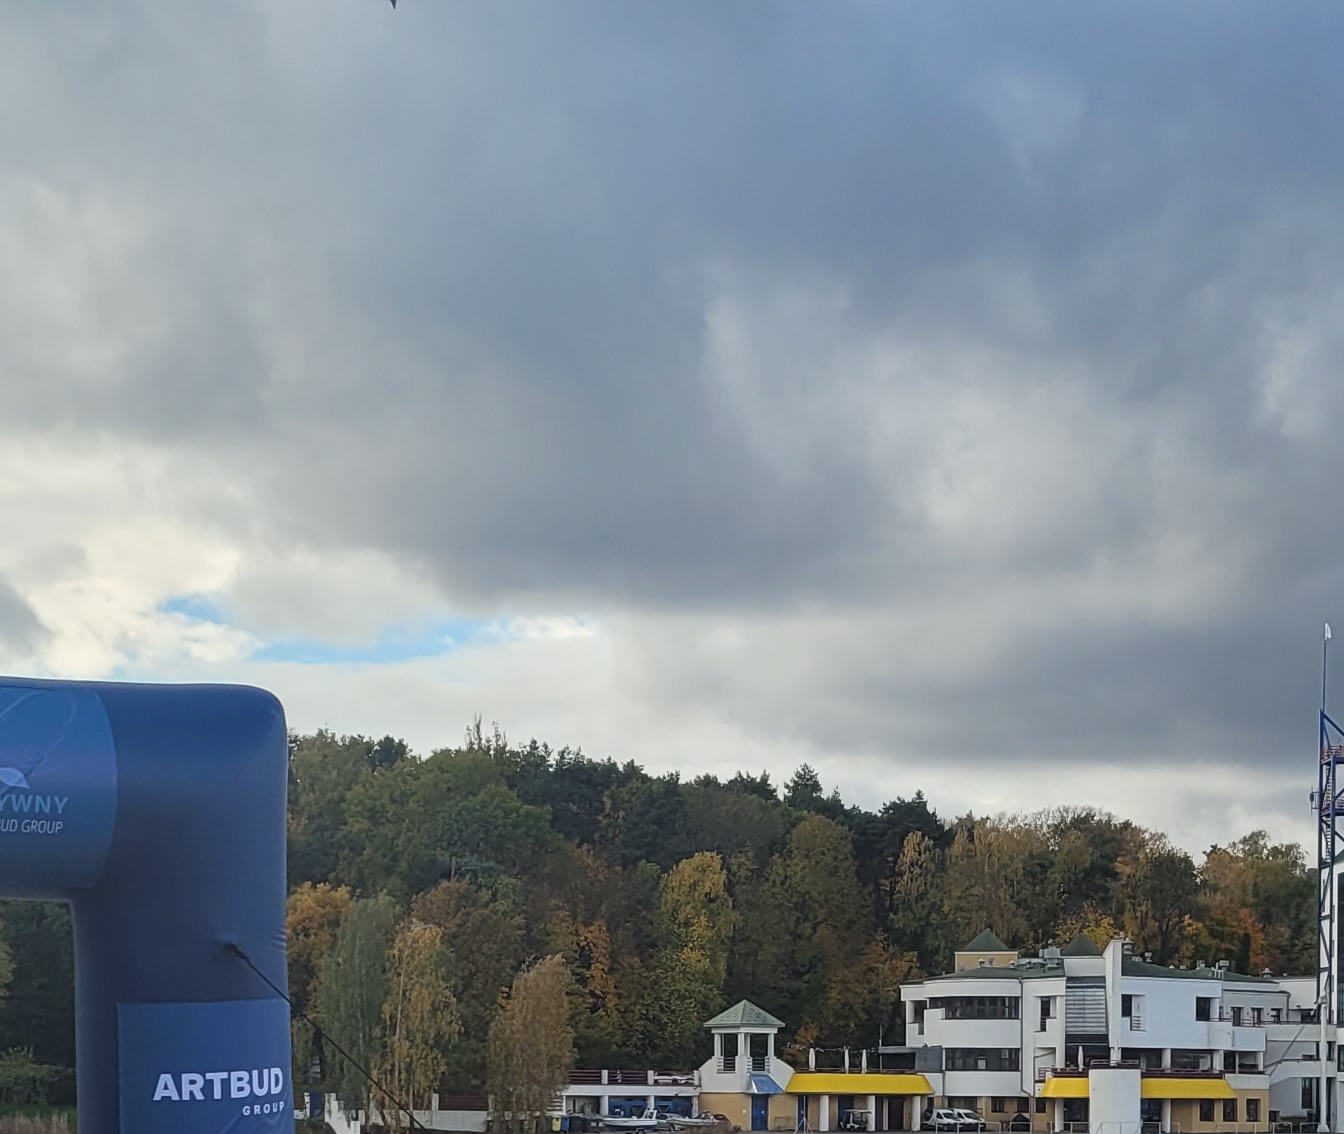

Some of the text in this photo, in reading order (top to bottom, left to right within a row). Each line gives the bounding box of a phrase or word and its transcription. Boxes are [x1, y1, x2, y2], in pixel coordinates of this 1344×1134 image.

[21, 819, 64, 835] GROUP
[153, 1067, 284, 1101] ARTBUD
[242, 1102, 285, 1116] GROUP
